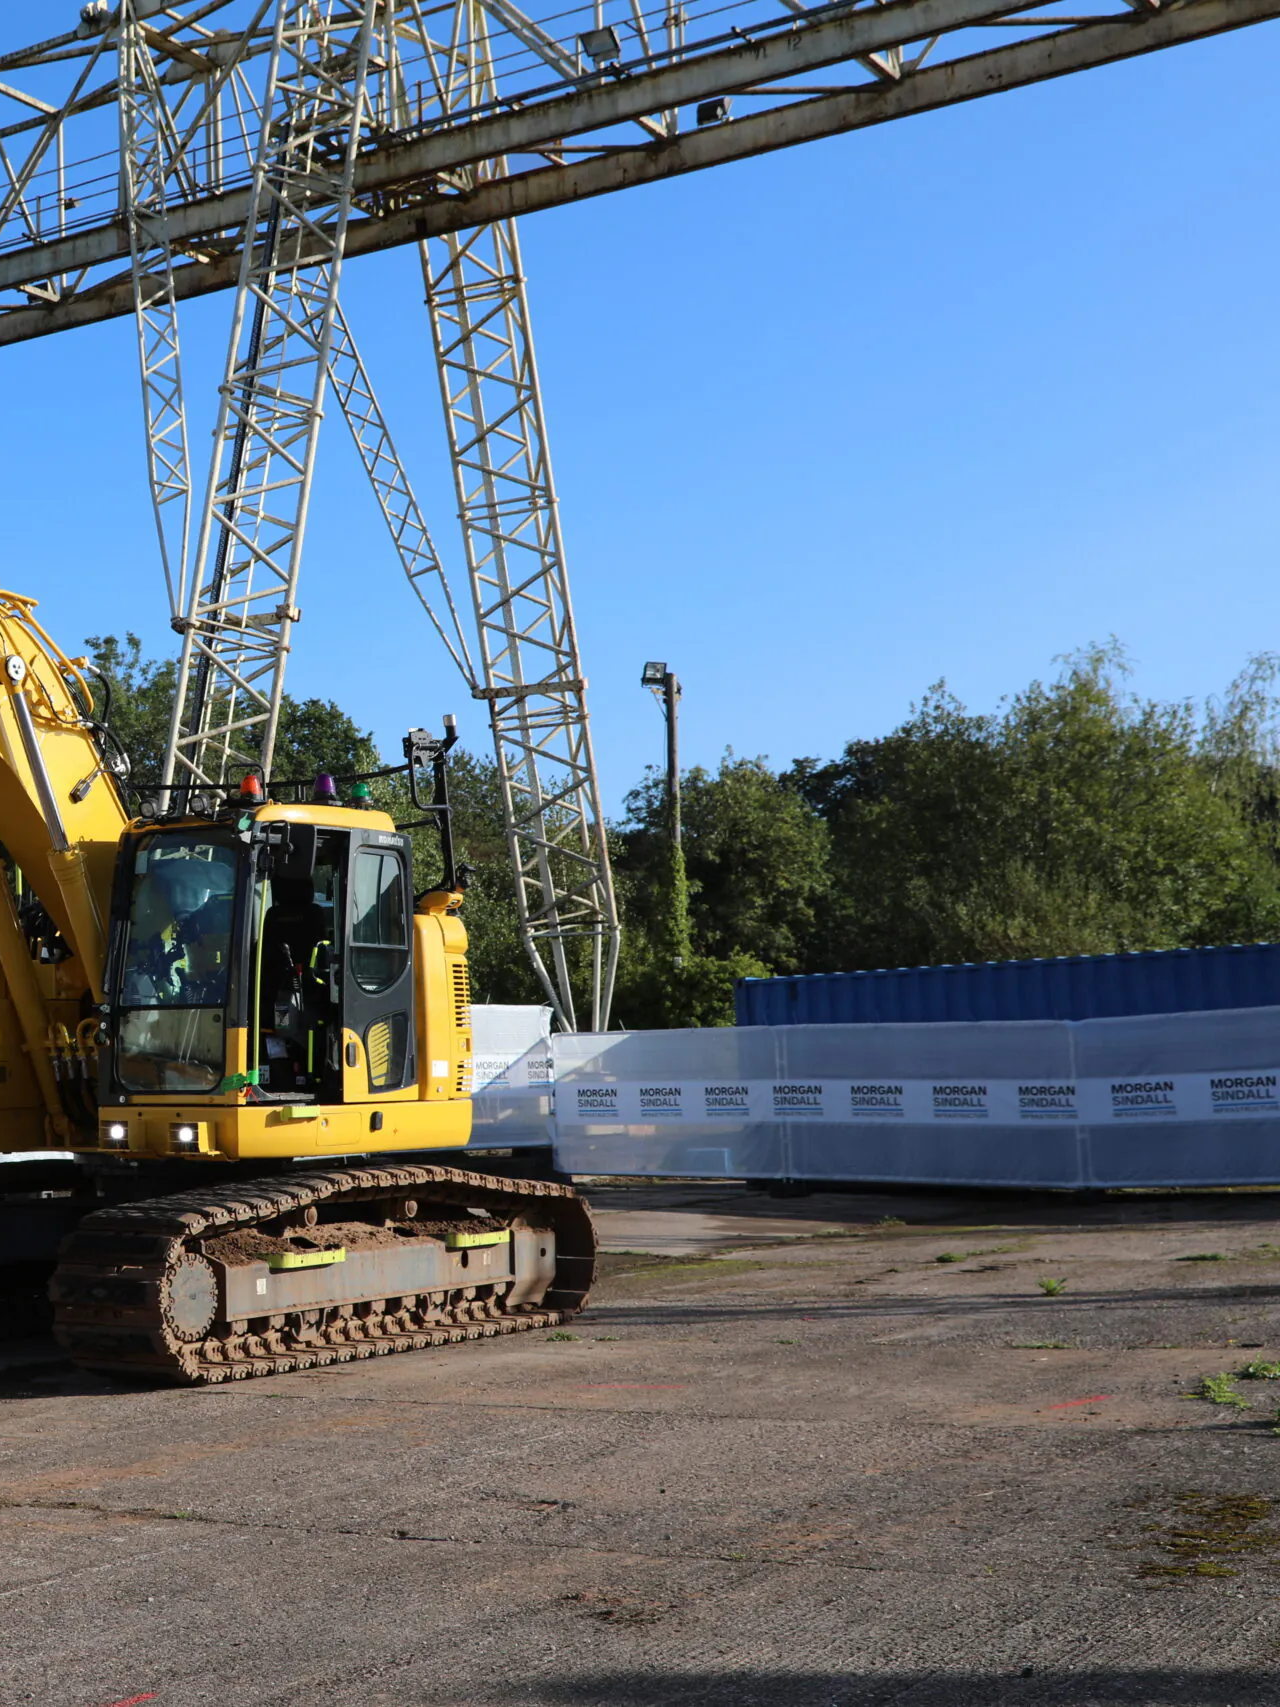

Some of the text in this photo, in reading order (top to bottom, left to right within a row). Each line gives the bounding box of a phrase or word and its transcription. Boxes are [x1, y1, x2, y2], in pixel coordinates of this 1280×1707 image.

[476, 1061, 509, 1070] MORGAN
[527, 1060, 552, 1070] MORG
[1111, 1080, 1174, 1094] MORGAN
[1210, 1076, 1276, 1089] MORGAN
[577, 1088, 617, 1098] MORGAN
[640, 1088, 681, 1097] MORGAN
[704, 1086, 749, 1096] MORGAN
[773, 1085, 822, 1095] MORGAN
[851, 1085, 903, 1095] MORGAN
[933, 1086, 987, 1096] MORGAN
[1018, 1086, 1076, 1096] MORGAN
[1211, 1088, 1275, 1101] SINDALL
[577, 1098, 616, 1108] SINDALL
[640, 1098, 680, 1107] SINDALL
[705, 1097, 747, 1106] SINDALL
[773, 1096, 821, 1106] SINDALL
[851, 1096, 901, 1106] SINDALL
[933, 1097, 985, 1107] SINDALL
[1019, 1097, 1074, 1108] SINDALL
[1112, 1093, 1172, 1106] SINDALL
